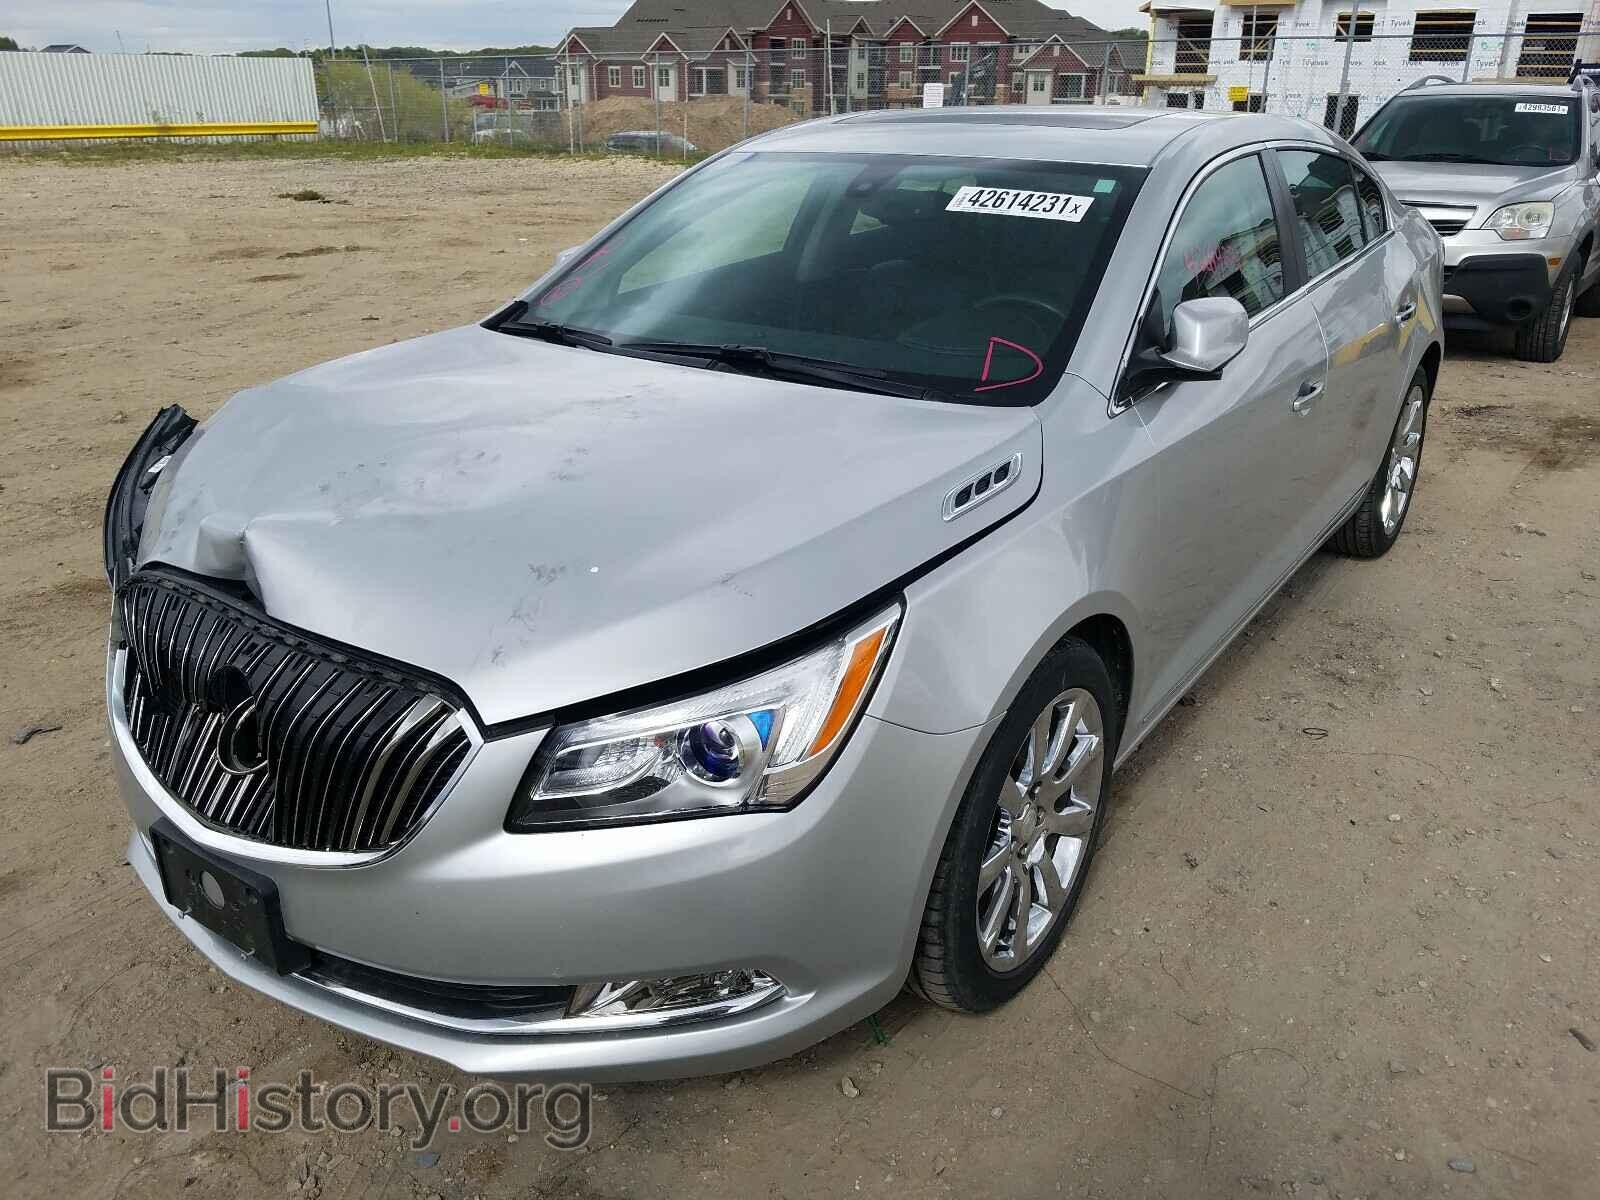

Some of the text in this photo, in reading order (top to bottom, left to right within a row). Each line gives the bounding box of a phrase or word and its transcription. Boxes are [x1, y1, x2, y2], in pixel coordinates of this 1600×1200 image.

[1391, 18, 1412, 28] Tyvek
[968, 189, 1072, 215] 42614231
[974, 336, 1044, 392] D
